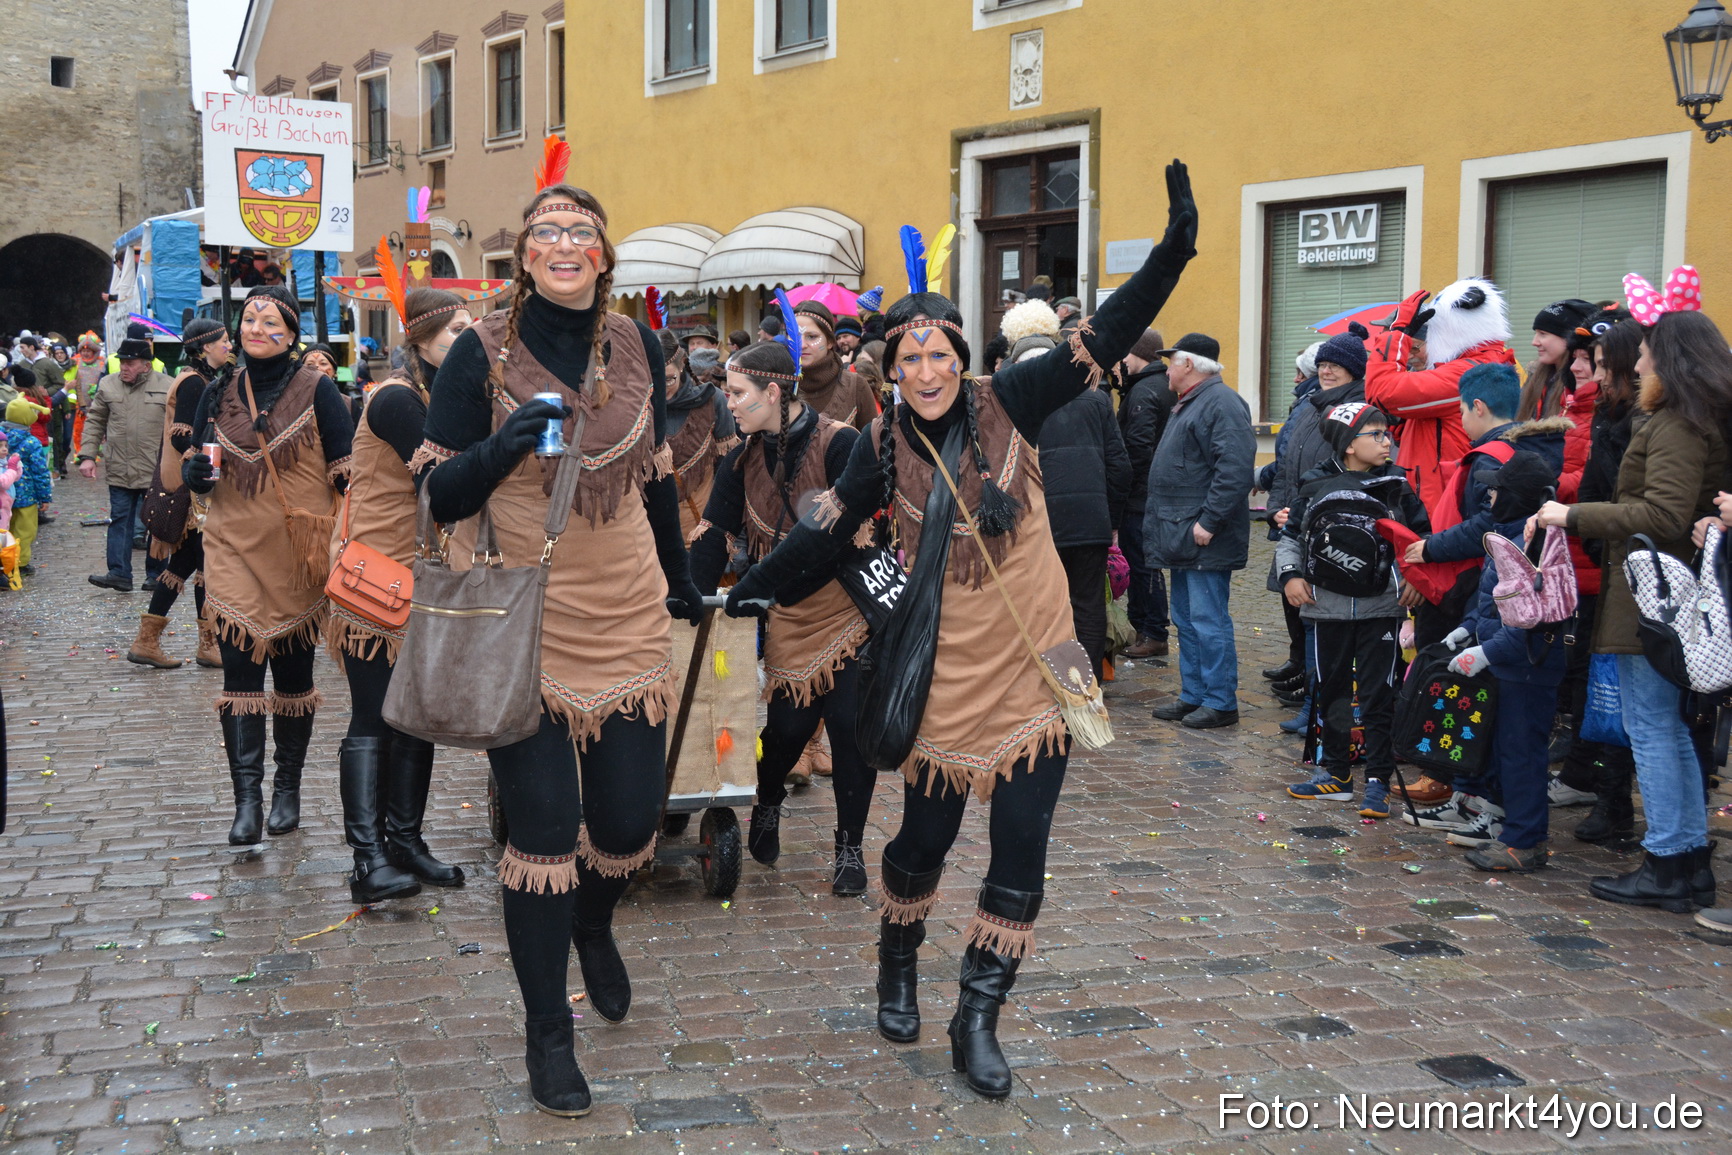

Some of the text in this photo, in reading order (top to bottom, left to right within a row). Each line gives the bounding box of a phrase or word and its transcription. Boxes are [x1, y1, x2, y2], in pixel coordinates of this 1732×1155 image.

[240, 94, 343, 119] Mühlhausen
[211, 110, 349, 146] Grüßt Bacham
[330, 206, 350, 223] 23
[1301, 208, 1374, 243] BW
[1297, 245, 1376, 264] Bekleidung
[1320, 545, 1368, 572] NIKE
